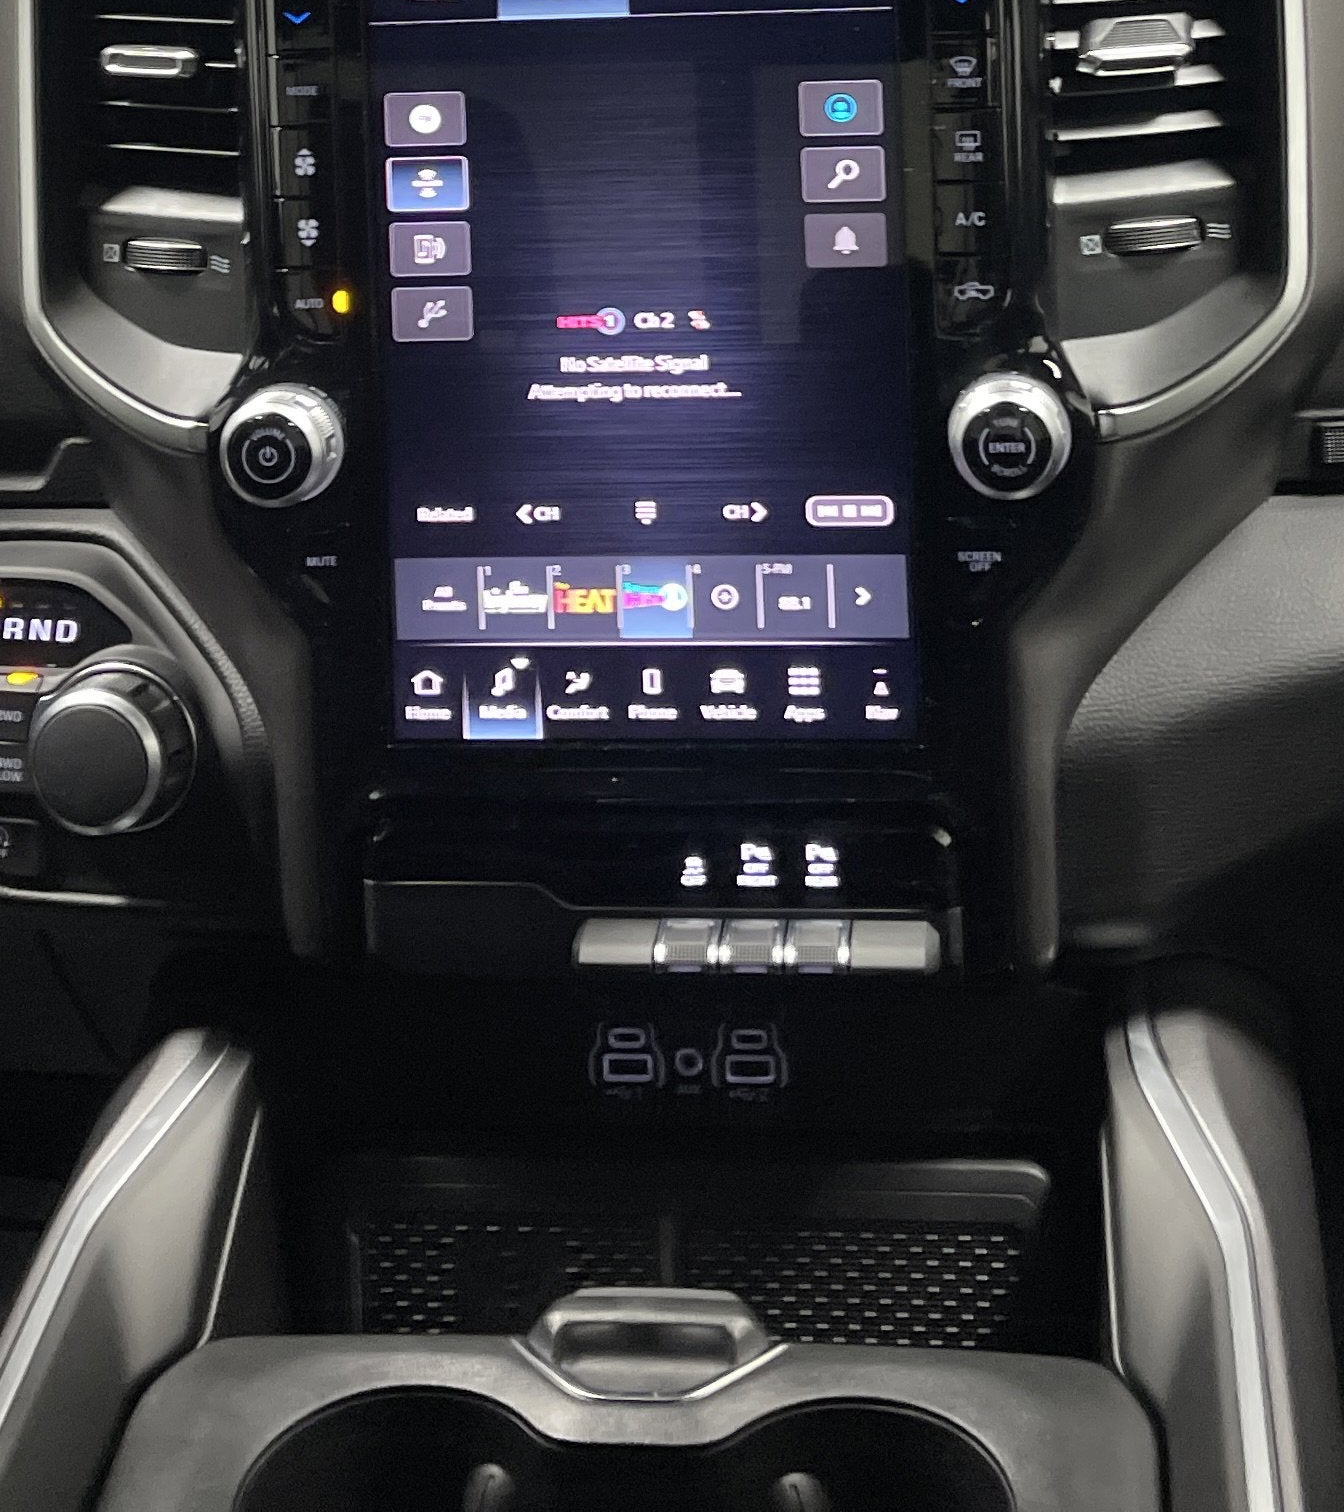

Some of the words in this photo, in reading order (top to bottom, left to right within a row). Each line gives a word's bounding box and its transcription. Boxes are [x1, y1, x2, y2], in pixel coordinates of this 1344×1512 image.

[956, 212, 986, 226] A/C
[988, 442, 1026, 453] ENTER
[306, 555, 337, 567] MUTE
[957, 551, 1002, 562] SCREEN
[969, 562, 992, 572] OFF
